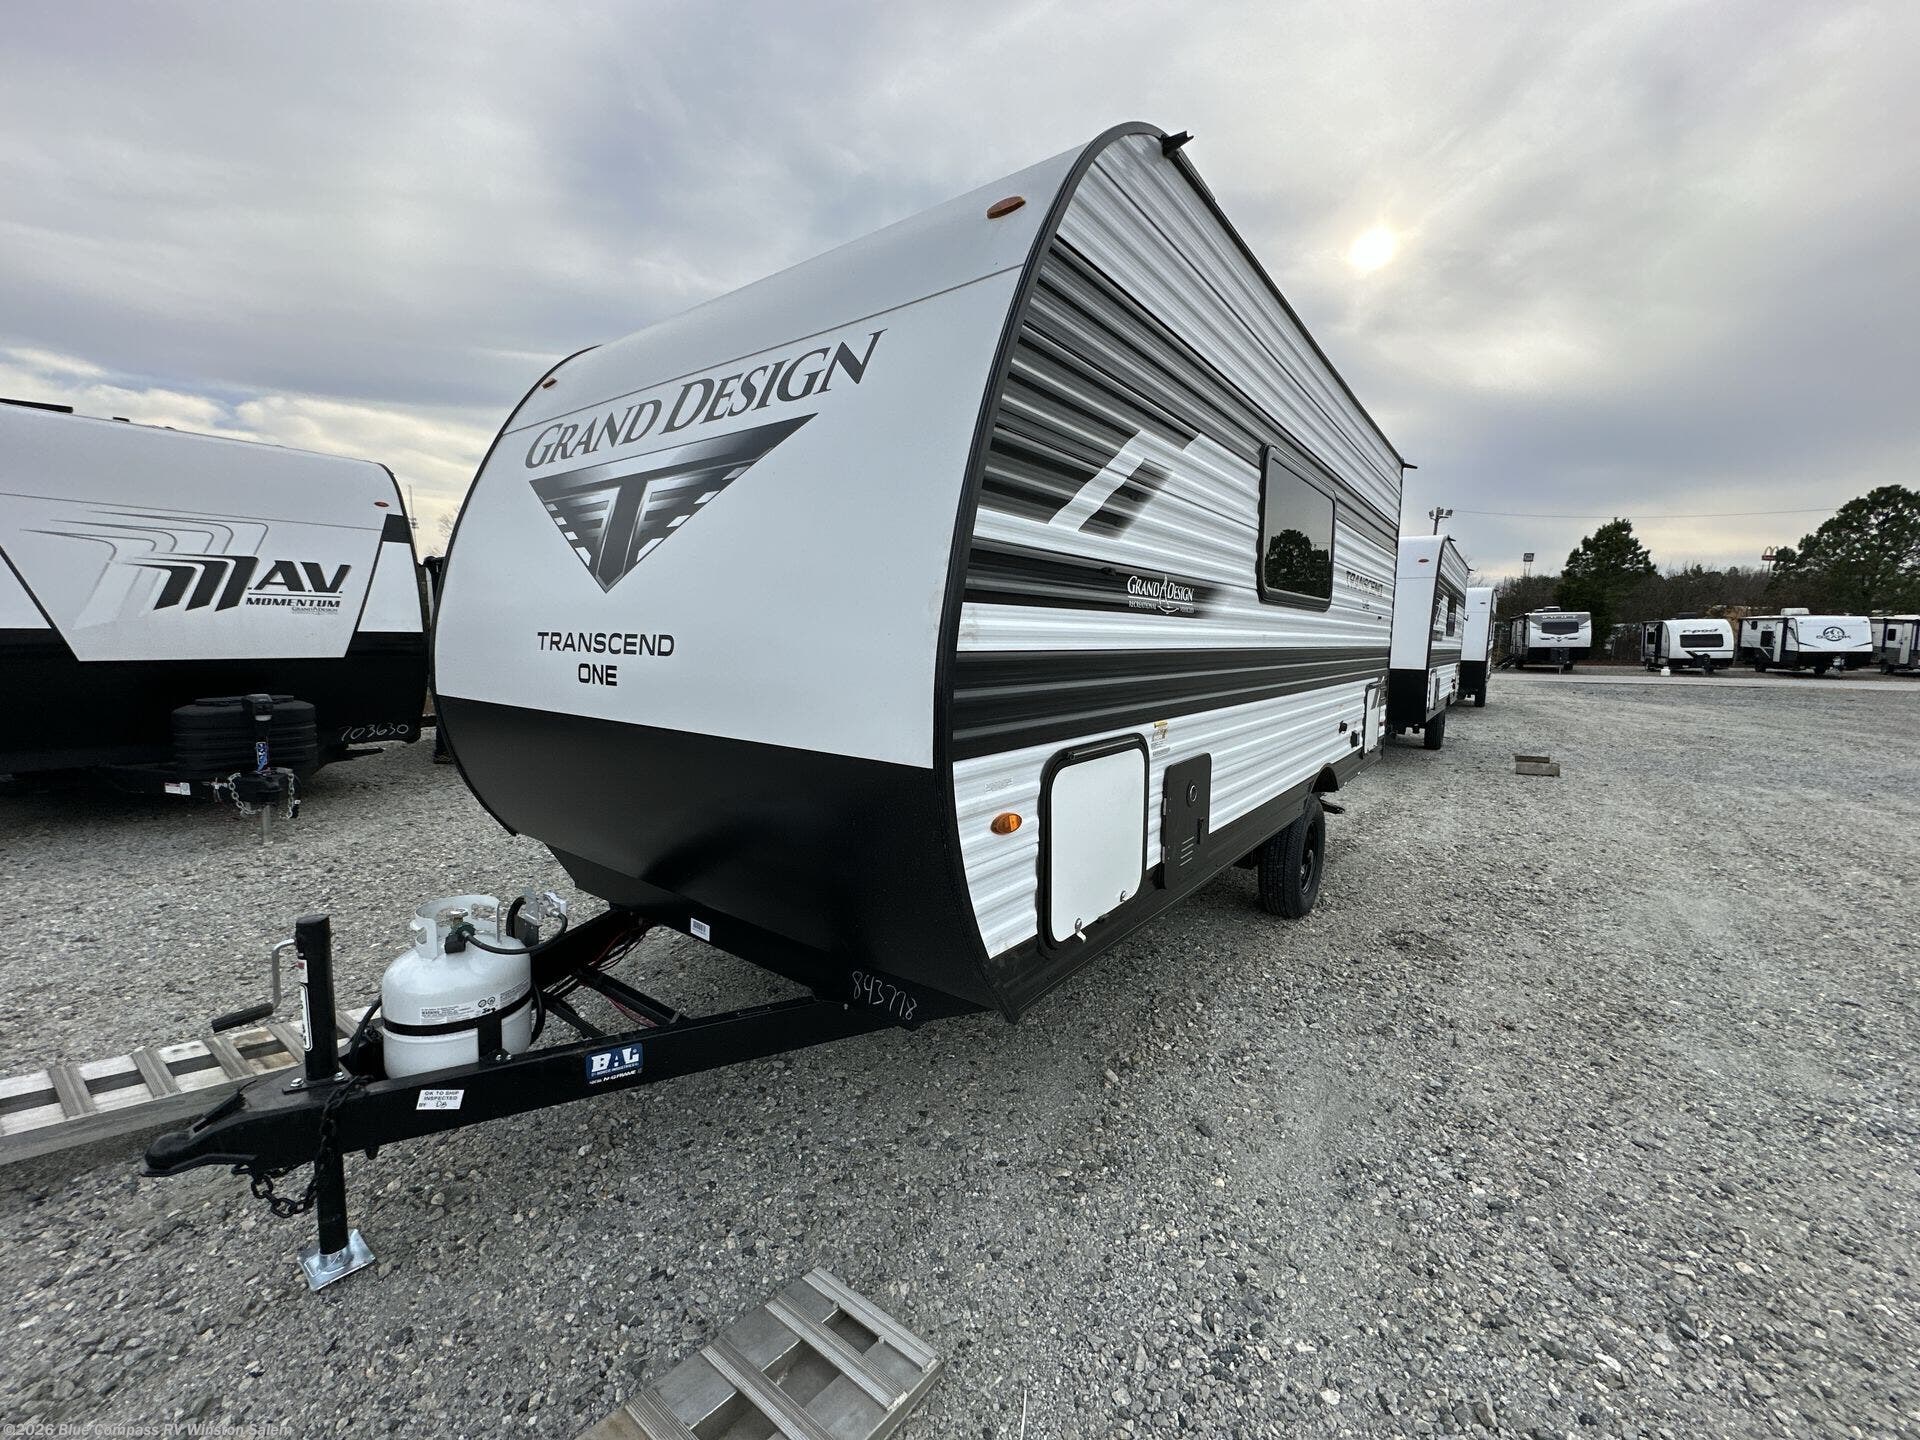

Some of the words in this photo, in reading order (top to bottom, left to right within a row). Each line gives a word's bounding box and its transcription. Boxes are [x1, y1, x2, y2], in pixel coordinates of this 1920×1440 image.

[525, 400, 663, 469] GRAND
[658, 328, 888, 435] DESIGN
[1127, 576, 1160, 597] GRAND
[1167, 582, 1194, 602] DESIGN
[246, 597, 341, 608] MOMENTUM
[537, 631, 675, 657] TRANSCEND
[578, 663, 618, 686] ONE
[851, 970, 918, 1020] 843778
[591, 1047, 640, 1073] BAL
